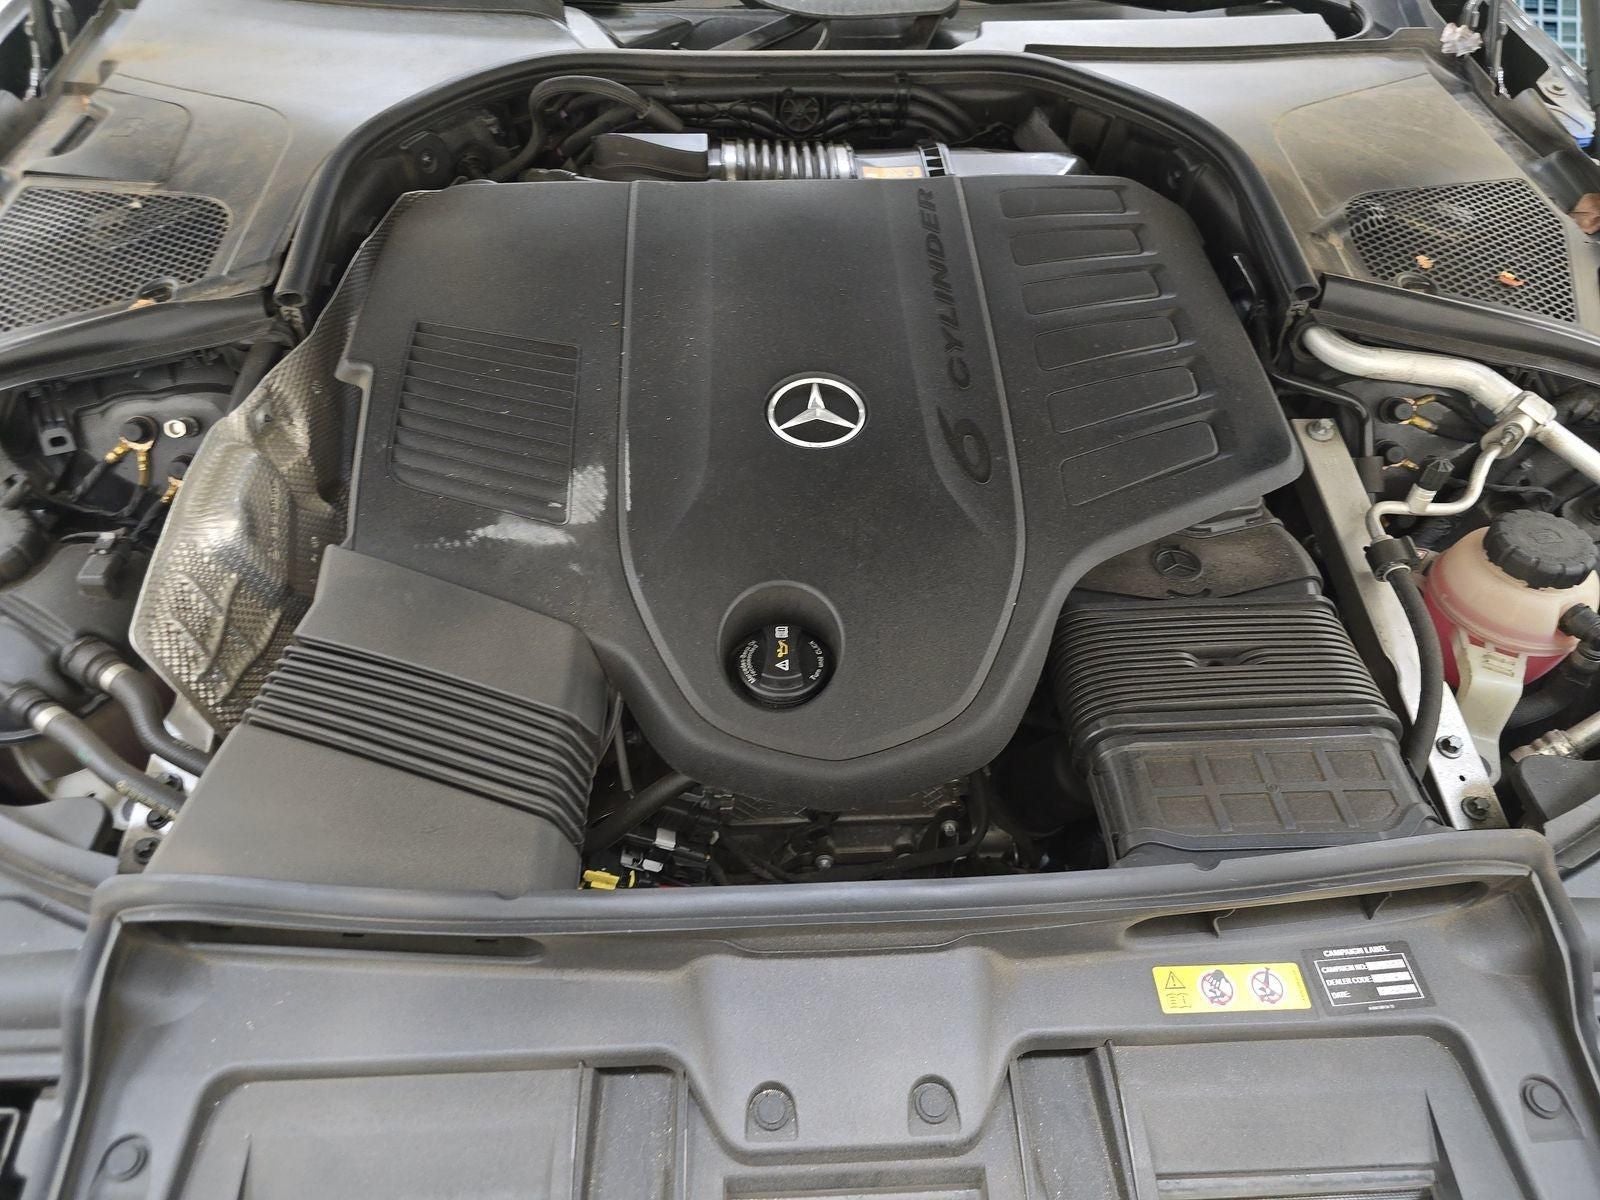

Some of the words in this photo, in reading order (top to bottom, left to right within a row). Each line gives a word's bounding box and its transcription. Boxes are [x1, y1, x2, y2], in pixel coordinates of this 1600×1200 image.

[918, 188, 971, 390] CYLINDER
[937, 405, 992, 485] 6
[1322, 947, 1364, 957] CAMPAIGN
[1364, 945, 1390, 954] LABEL
[1321, 964, 1355, 973] CAMPAIGN
[1326, 977, 1352, 986] DEALER
